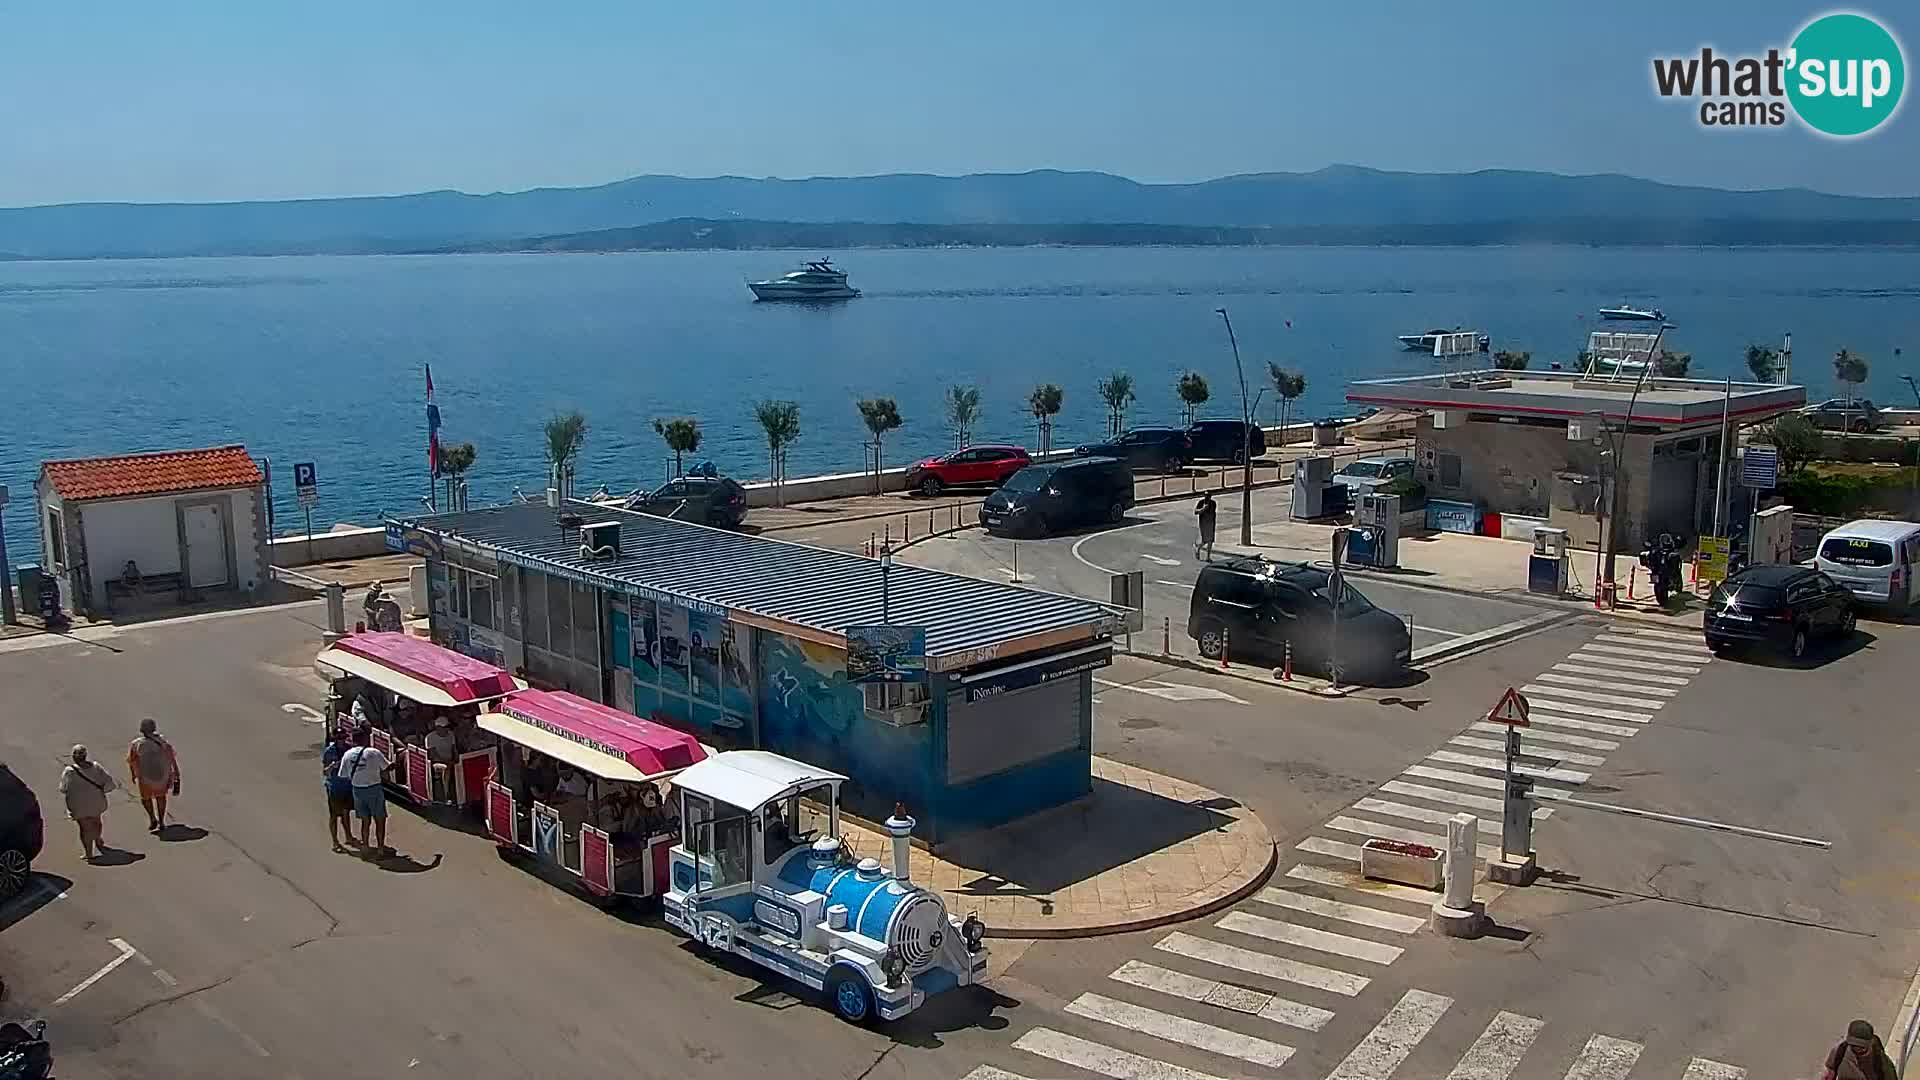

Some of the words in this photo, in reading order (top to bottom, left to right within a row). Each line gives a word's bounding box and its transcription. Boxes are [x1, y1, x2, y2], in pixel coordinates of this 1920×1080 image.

[299, 466, 310, 483] P
[1849, 540, 1869, 548] TAXI
[585, 575, 615, 588] POSTAJA
[624, 584, 639, 595] BUS
[640, 588, 671, 602] STATION
[674, 596, 697, 609] TICKET
[699, 602, 725, 616] OFFICE
[512, 711, 532, 726] CENTER
[536, 719, 554, 734] BEACH
[554, 726, 575, 741] ZLATNI
[575, 734, 585, 745] RAT
[589, 739, 602, 752] BOL
[602, 744, 625, 759] CENTER
